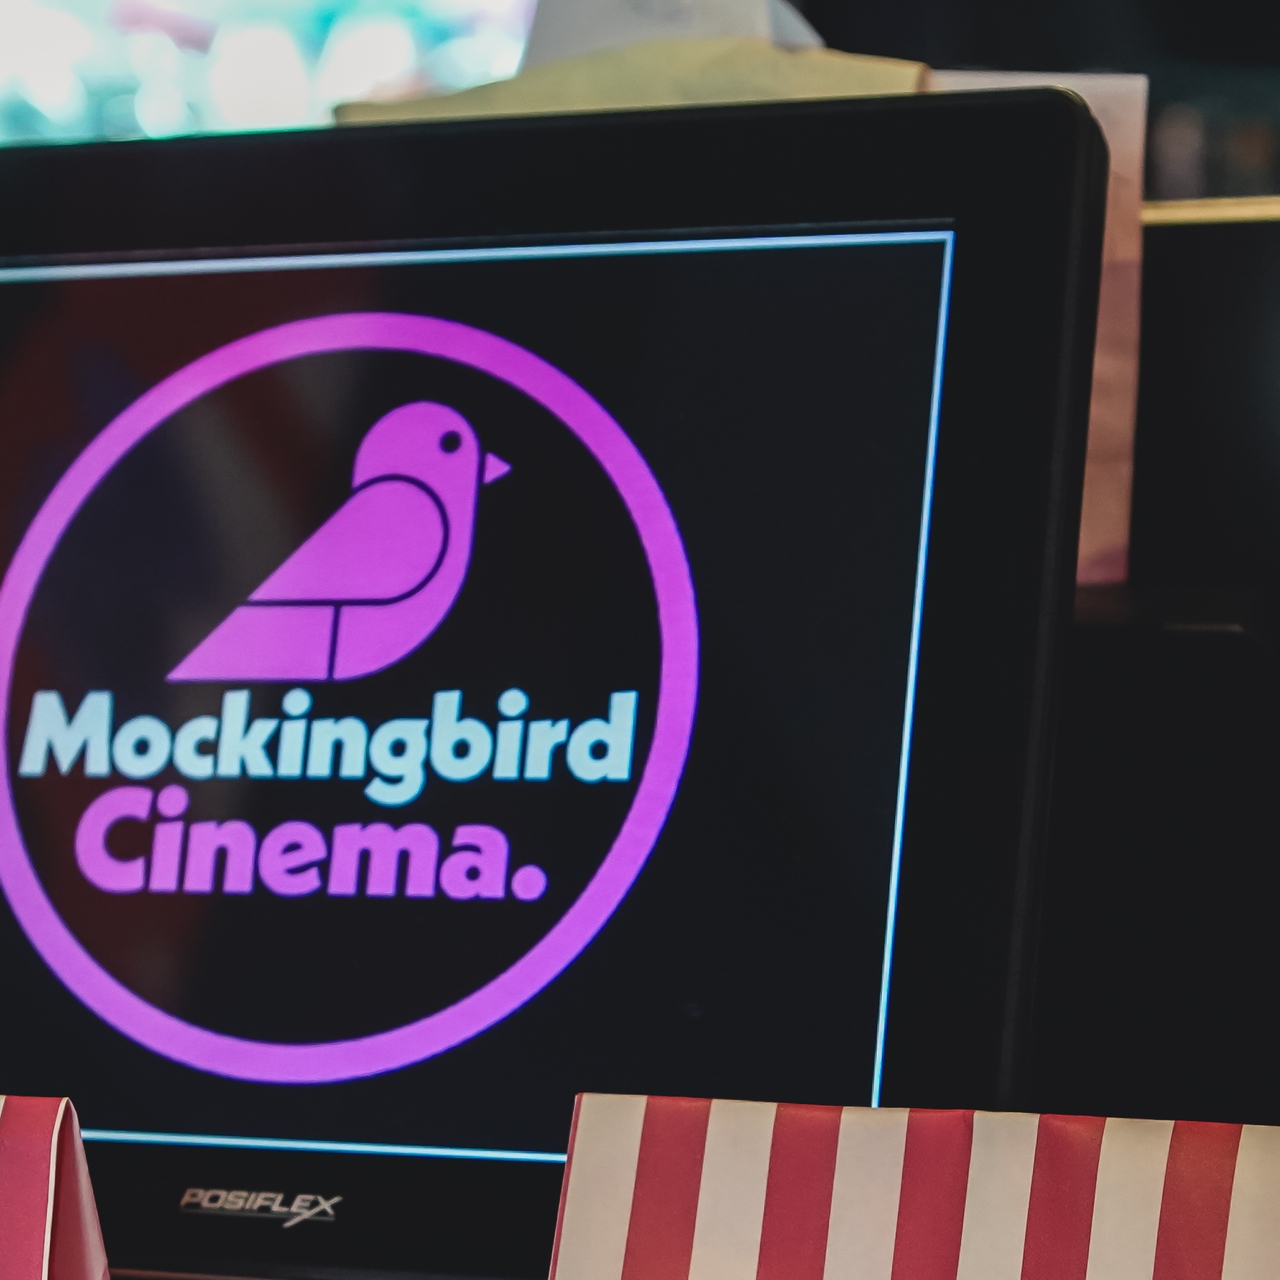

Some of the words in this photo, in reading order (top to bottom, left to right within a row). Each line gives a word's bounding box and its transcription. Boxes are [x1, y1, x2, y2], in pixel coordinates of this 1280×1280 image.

[18, 687, 638, 806] Mockingbird
[74, 783, 548, 901] Cinema.
[179, 1187, 343, 1228] POSIFLEX
